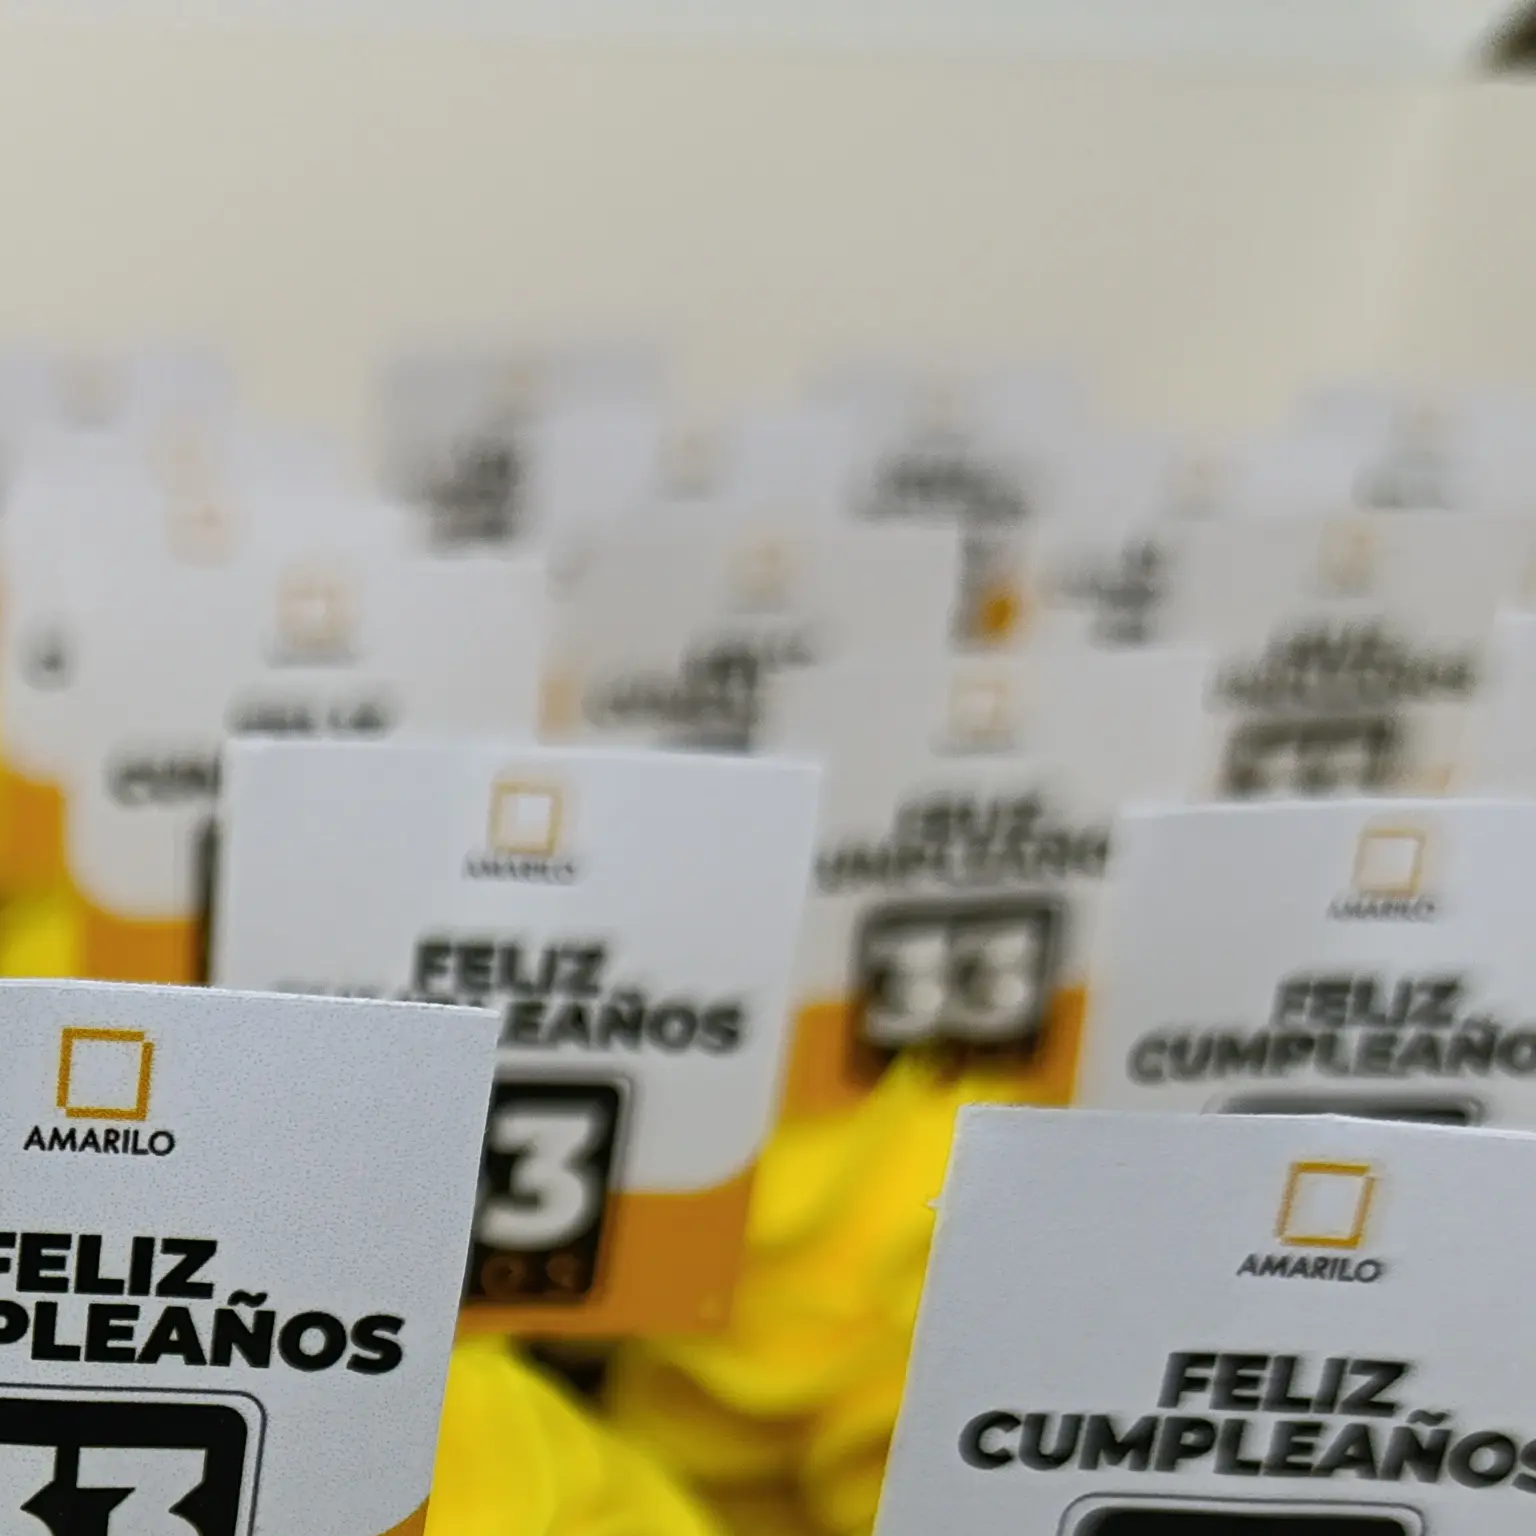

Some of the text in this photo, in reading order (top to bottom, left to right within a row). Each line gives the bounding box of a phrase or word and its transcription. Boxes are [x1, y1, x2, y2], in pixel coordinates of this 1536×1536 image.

[414, 938, 607, 994] FELIZ
[1274, 975, 1463, 1029] FELIZ
[1128, 1012, 1536, 1084] CUMPLEAÑO
[23, 1125, 176, 1157] AMARILO
[478, 1110, 597, 1248] 3
[1236, 1253, 1385, 1284] AMARILO
[1157, 1351, 1412, 1418] FELIZ
